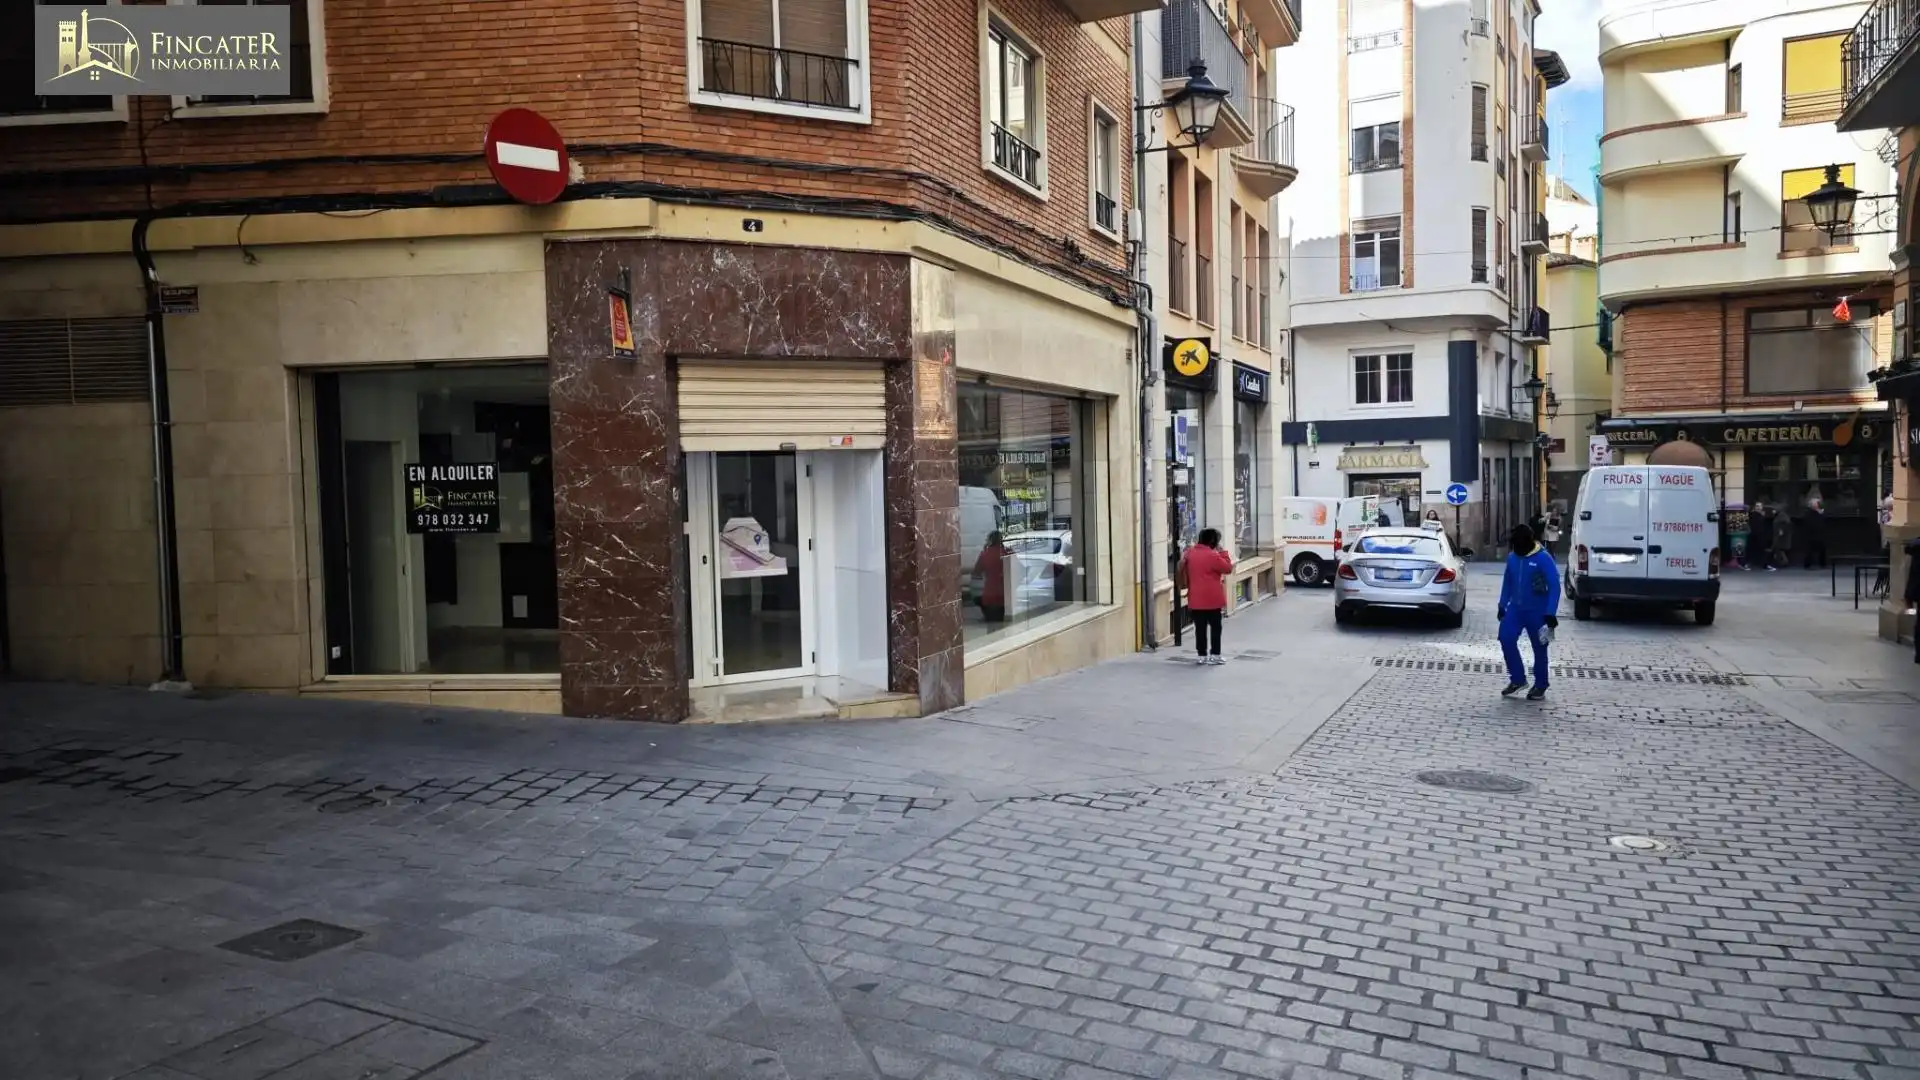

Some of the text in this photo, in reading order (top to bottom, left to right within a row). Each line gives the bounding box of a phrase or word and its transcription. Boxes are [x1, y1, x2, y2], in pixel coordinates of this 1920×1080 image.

[1724, 424, 1822, 442] CAFETERÍA
[1338, 454, 1426, 468] FARMACIA
[409, 465, 494, 481] EN ALQUILER
[1603, 474, 1643, 485] FRUTAS
[418, 513, 489, 525] 978 032 347
[1665, 557, 1697, 568] TERUEL
